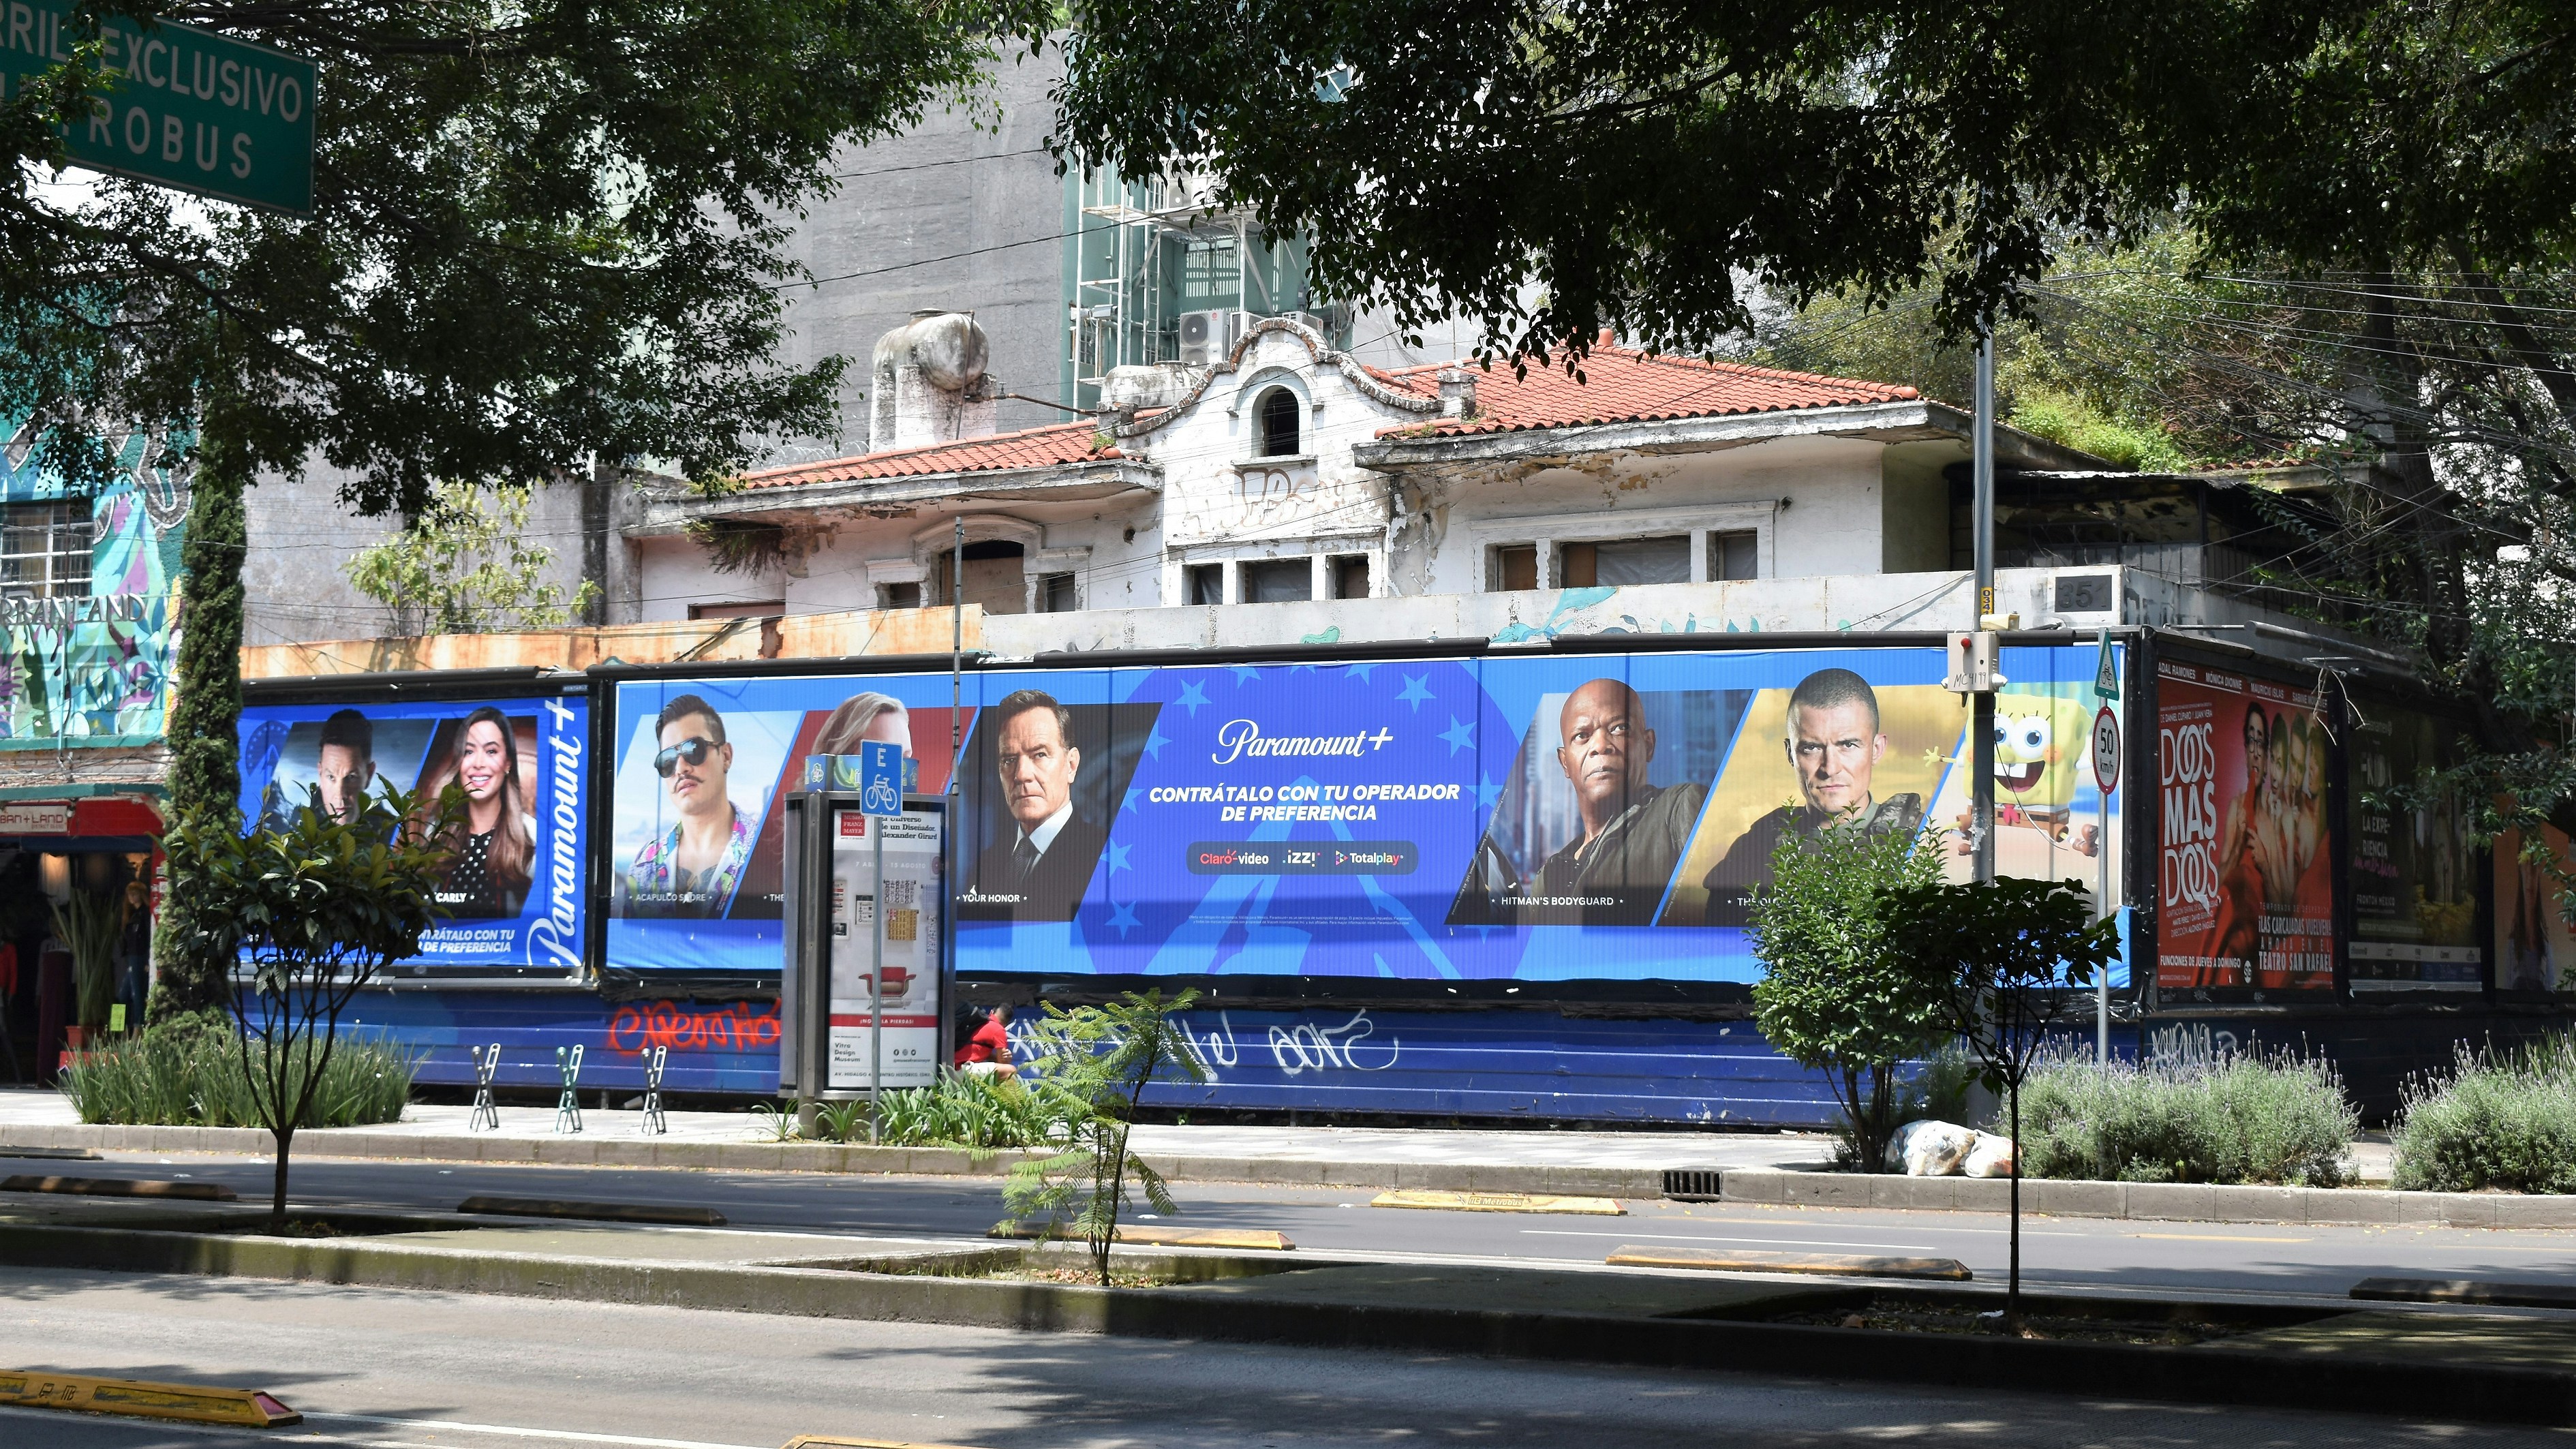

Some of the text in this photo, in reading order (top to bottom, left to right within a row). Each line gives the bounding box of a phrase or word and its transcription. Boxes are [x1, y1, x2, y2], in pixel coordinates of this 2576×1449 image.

[0, 1, 302, 123] RIL EXCLUSIVO
[2058, 580, 2107, 609] 351
[2158, 662, 2196, 680] ADAL RAMONES
[1212, 719, 1394, 765] Paramount+
[2100, 727, 2113, 755] 50
[877, 748, 887, 767] E
[2100, 757, 2113, 774] km/h
[1149, 782, 1460, 802] CONTRÁTALO CON TU OPERADOR
[1221, 805, 1377, 822] DE PREFERENCIA
[526, 697, 582, 967] Paramount+
[1349, 853, 1400, 866] Totalplay
[636, 893, 677, 902] ACAPULCO
[962, 894, 1020, 902] YOUR HONOR
[1501, 896, 1614, 906] HITMAN'S BODYGUARD
[474, 930, 498, 941] CON
[500, 929, 516, 940] TU
[424, 941, 438, 953] DE
[440, 941, 511, 953] PREFERENCIA
[2160, 955, 2241, 968] FUNCIONES DE JUEVES A DOMINGO
[2258, 951, 2286, 971] TEATRO
[2289, 952, 2303, 971] SAN
[2305, 953, 2333, 973] RAFAEL
